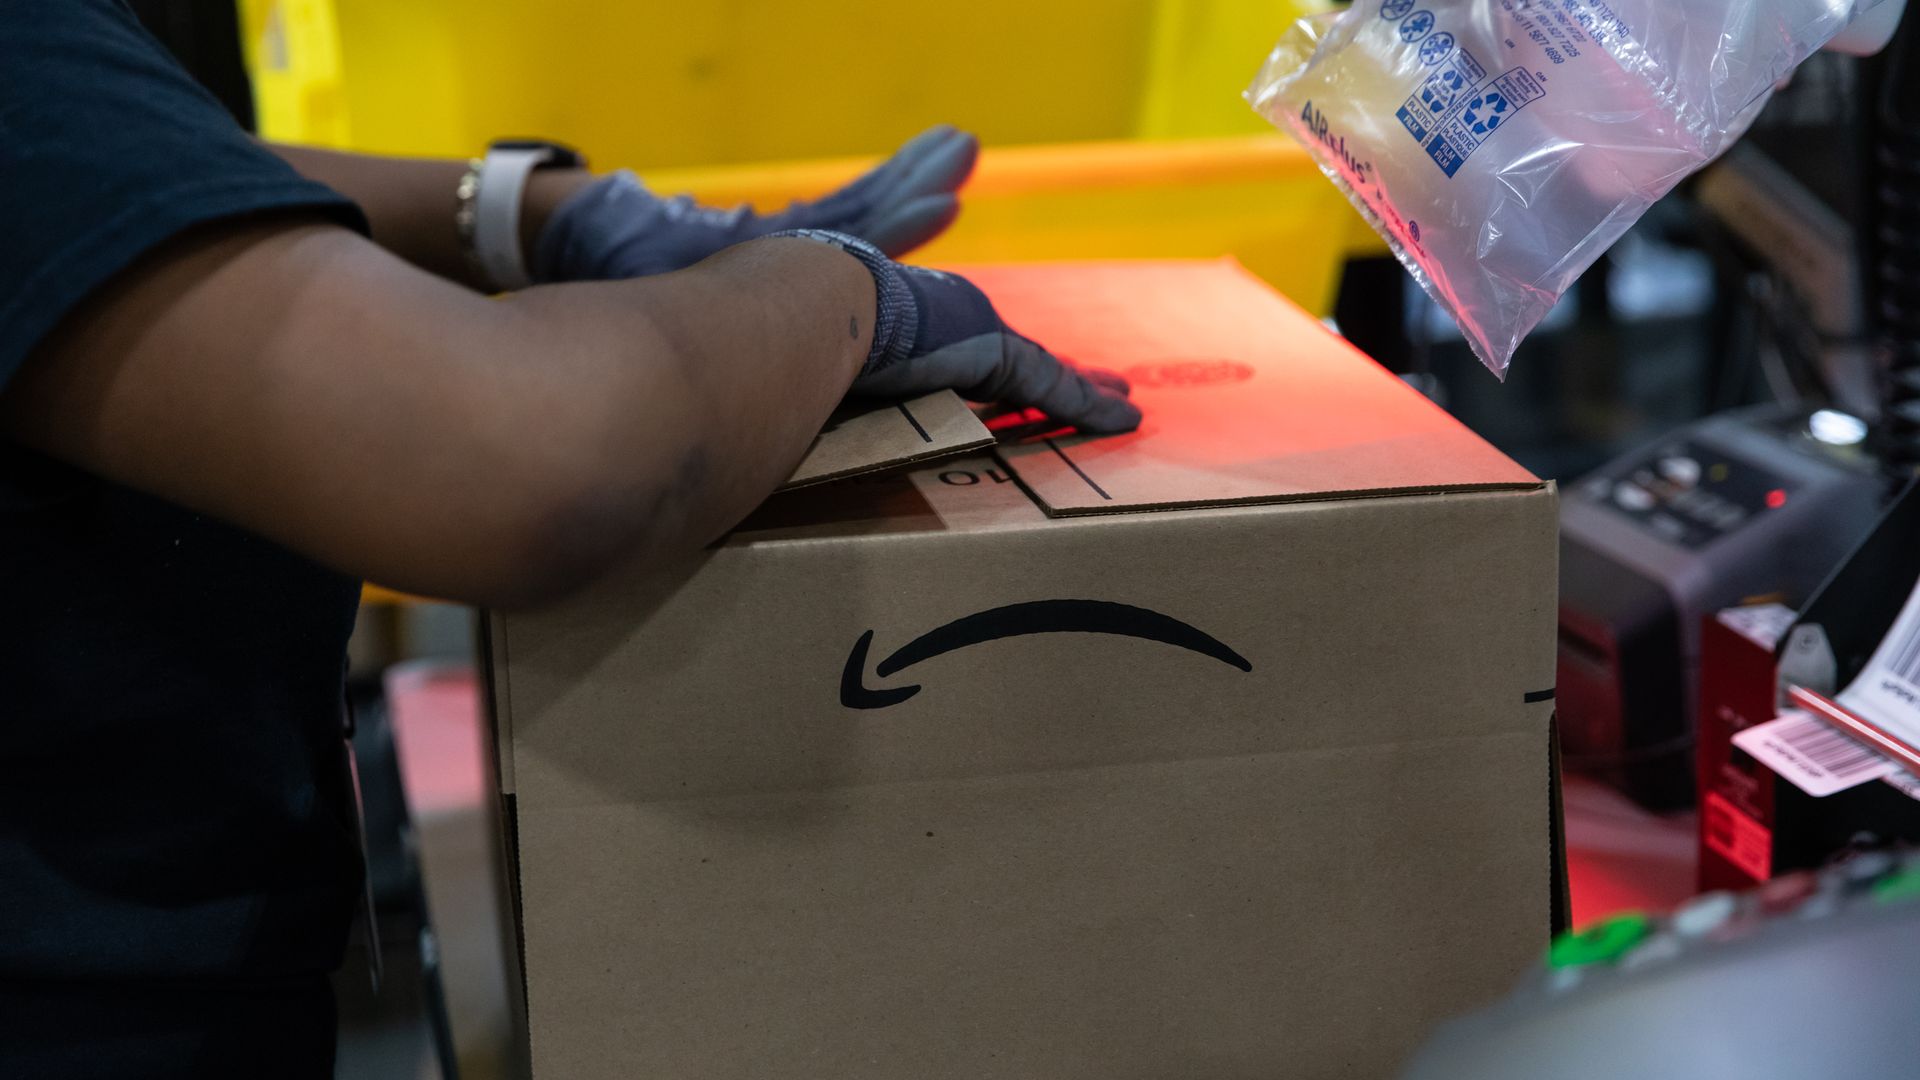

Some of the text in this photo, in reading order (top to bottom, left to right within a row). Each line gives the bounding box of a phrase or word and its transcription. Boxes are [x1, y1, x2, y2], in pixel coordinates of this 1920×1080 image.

[1545, 46, 1565, 64] 4699
[1560, 40, 1581, 57] 7225
[1402, 114, 1420, 132] FILM
[1407, 100, 1432, 128] PLASTIC
[1442, 127, 1470, 158] PLASTIQUE
[1449, 122, 1475, 150] PLASTIC
[1433, 149, 1450, 169] FILM
[1440, 142, 1456, 161] FILM
